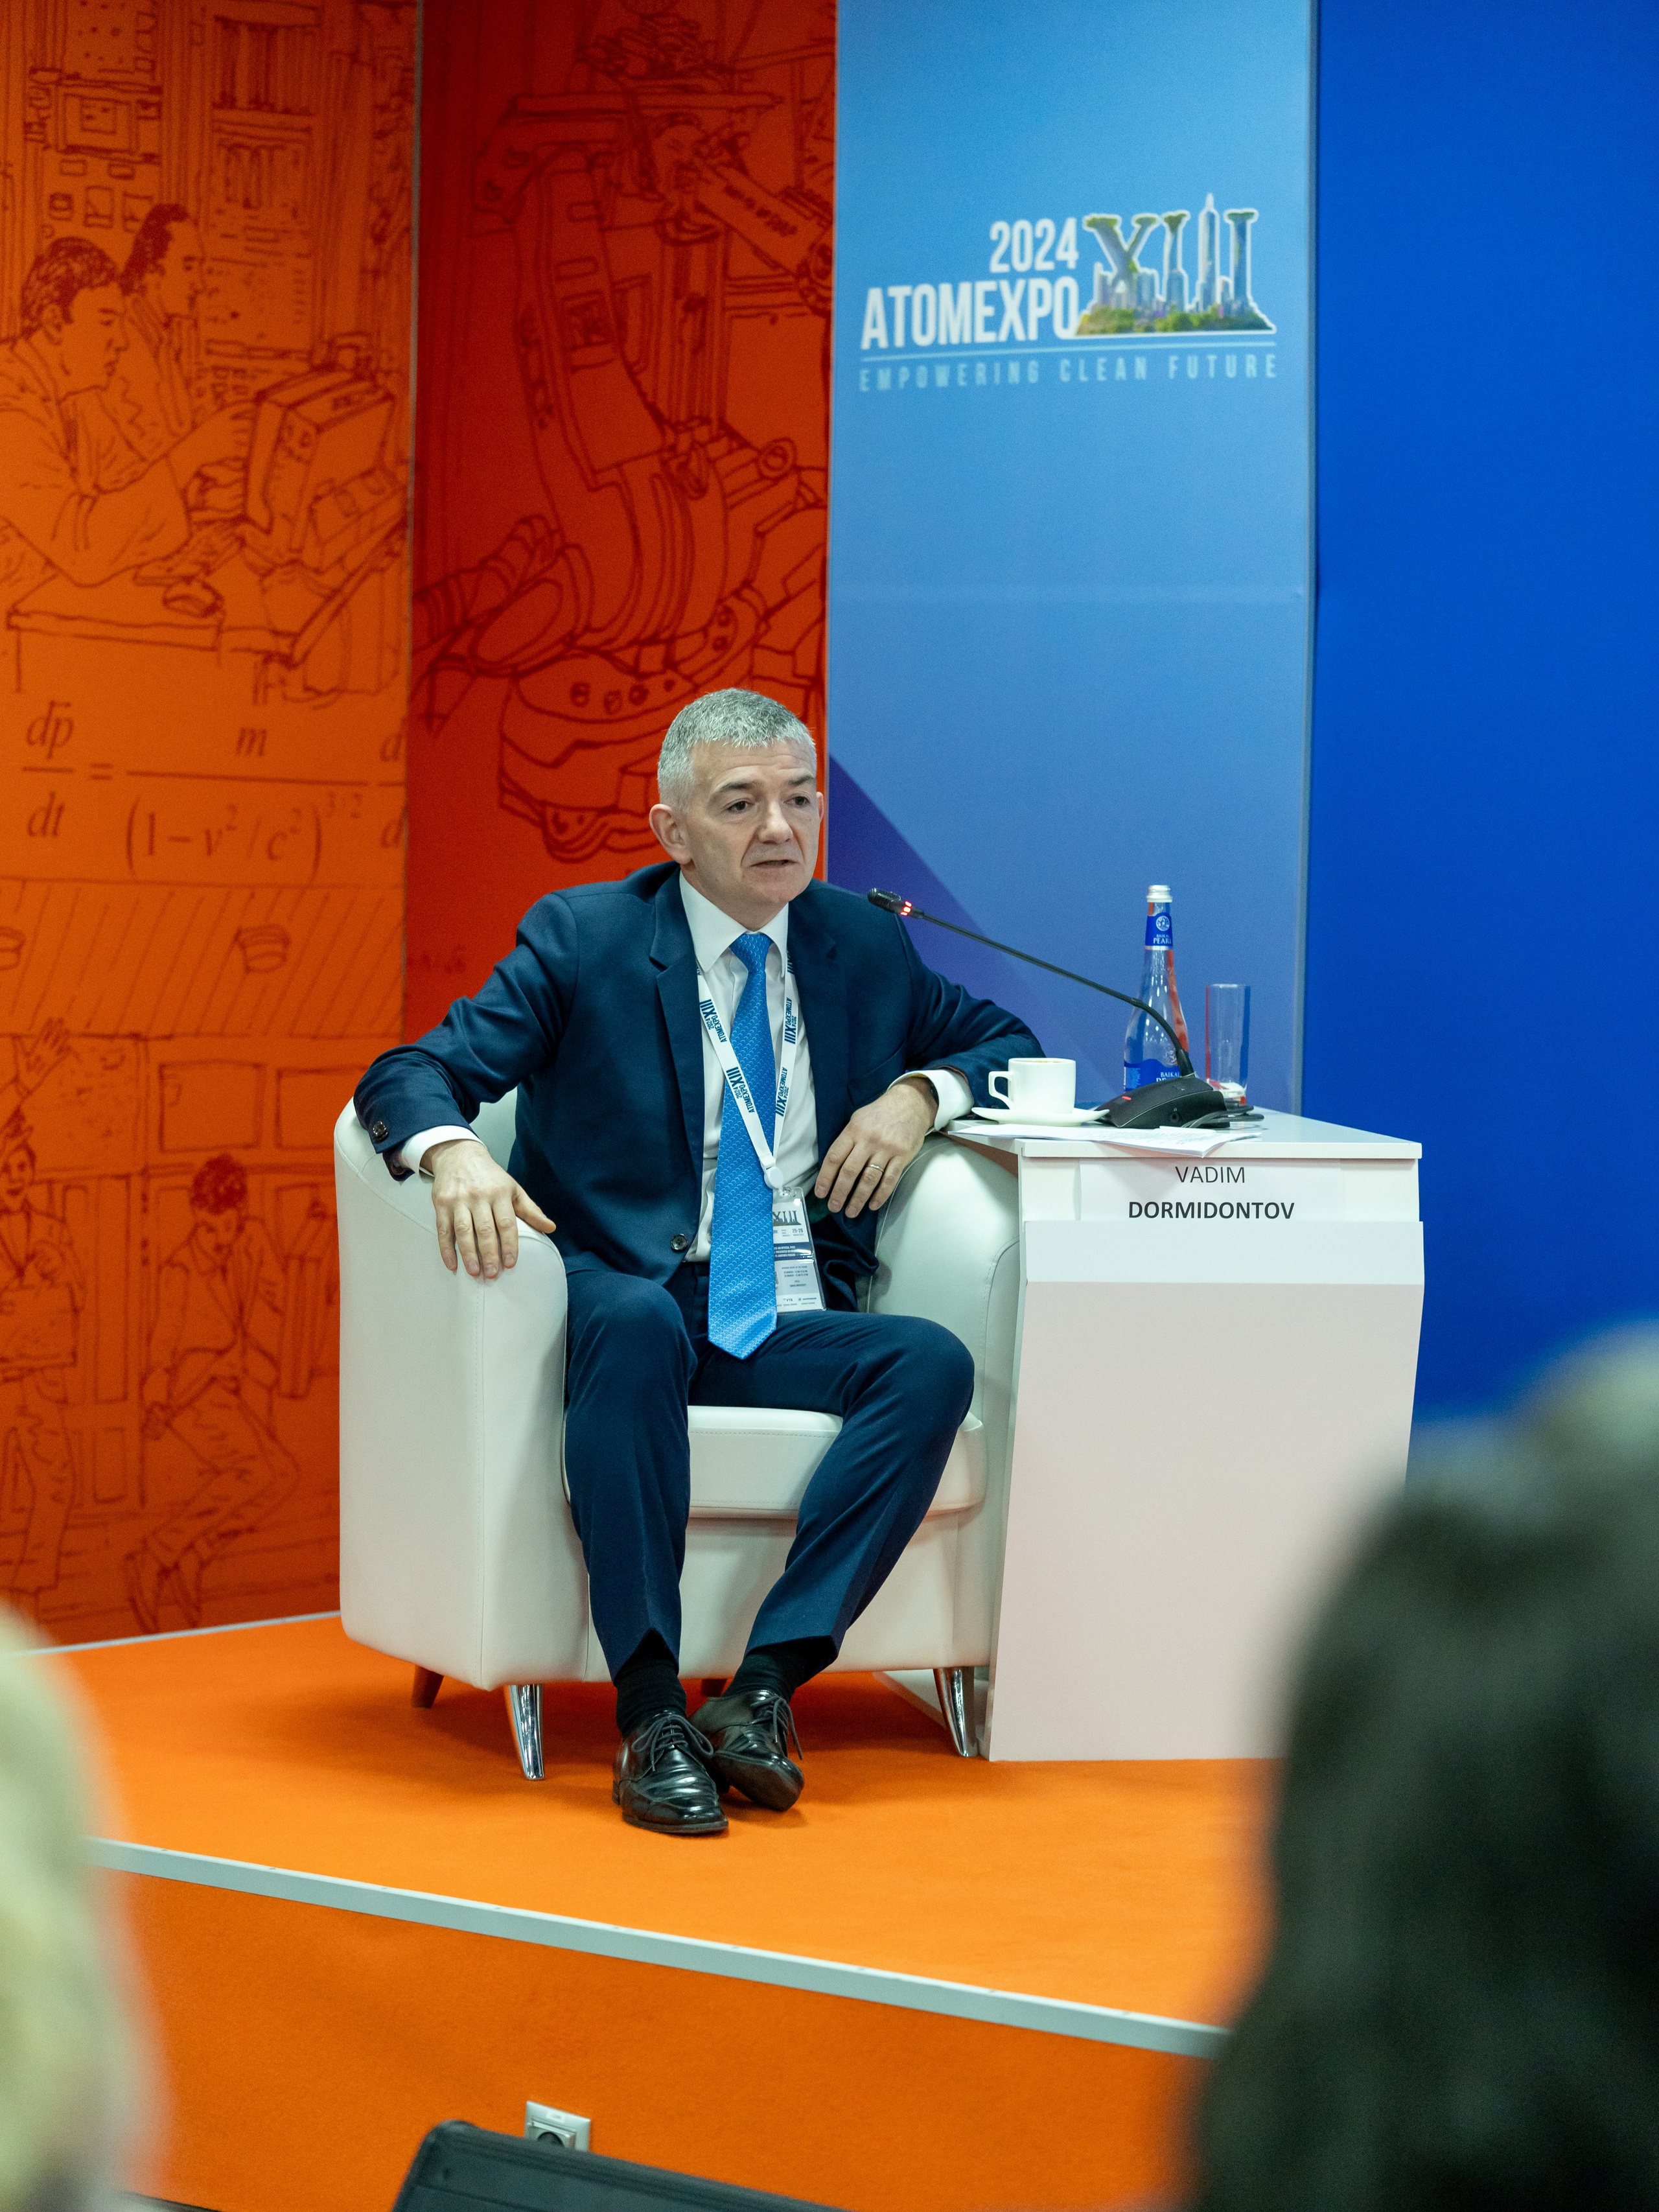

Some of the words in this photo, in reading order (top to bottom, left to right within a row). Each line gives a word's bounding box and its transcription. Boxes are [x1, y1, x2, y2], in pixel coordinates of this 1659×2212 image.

[989, 217, 1079, 274] 2024
[861, 276, 1079, 350] ATOMEXPO
[859, 360, 1039, 391] EMPOWERING
[1060, 356, 1148, 383] CLEAN
[1168, 353, 1277, 379] FUTURE
[705, 1018, 714, 1030] 2024
[711, 1015, 728, 1043] ATOMEXPO
[734, 1087, 742, 1099] 2024
[778, 1067, 787, 1097] ATOMEXPO
[739, 1084, 755, 1113] ATOMEXPO
[1175, 1167, 1246, 1183] VADIM
[1128, 1202, 1295, 1220] DORMIDONTOV
